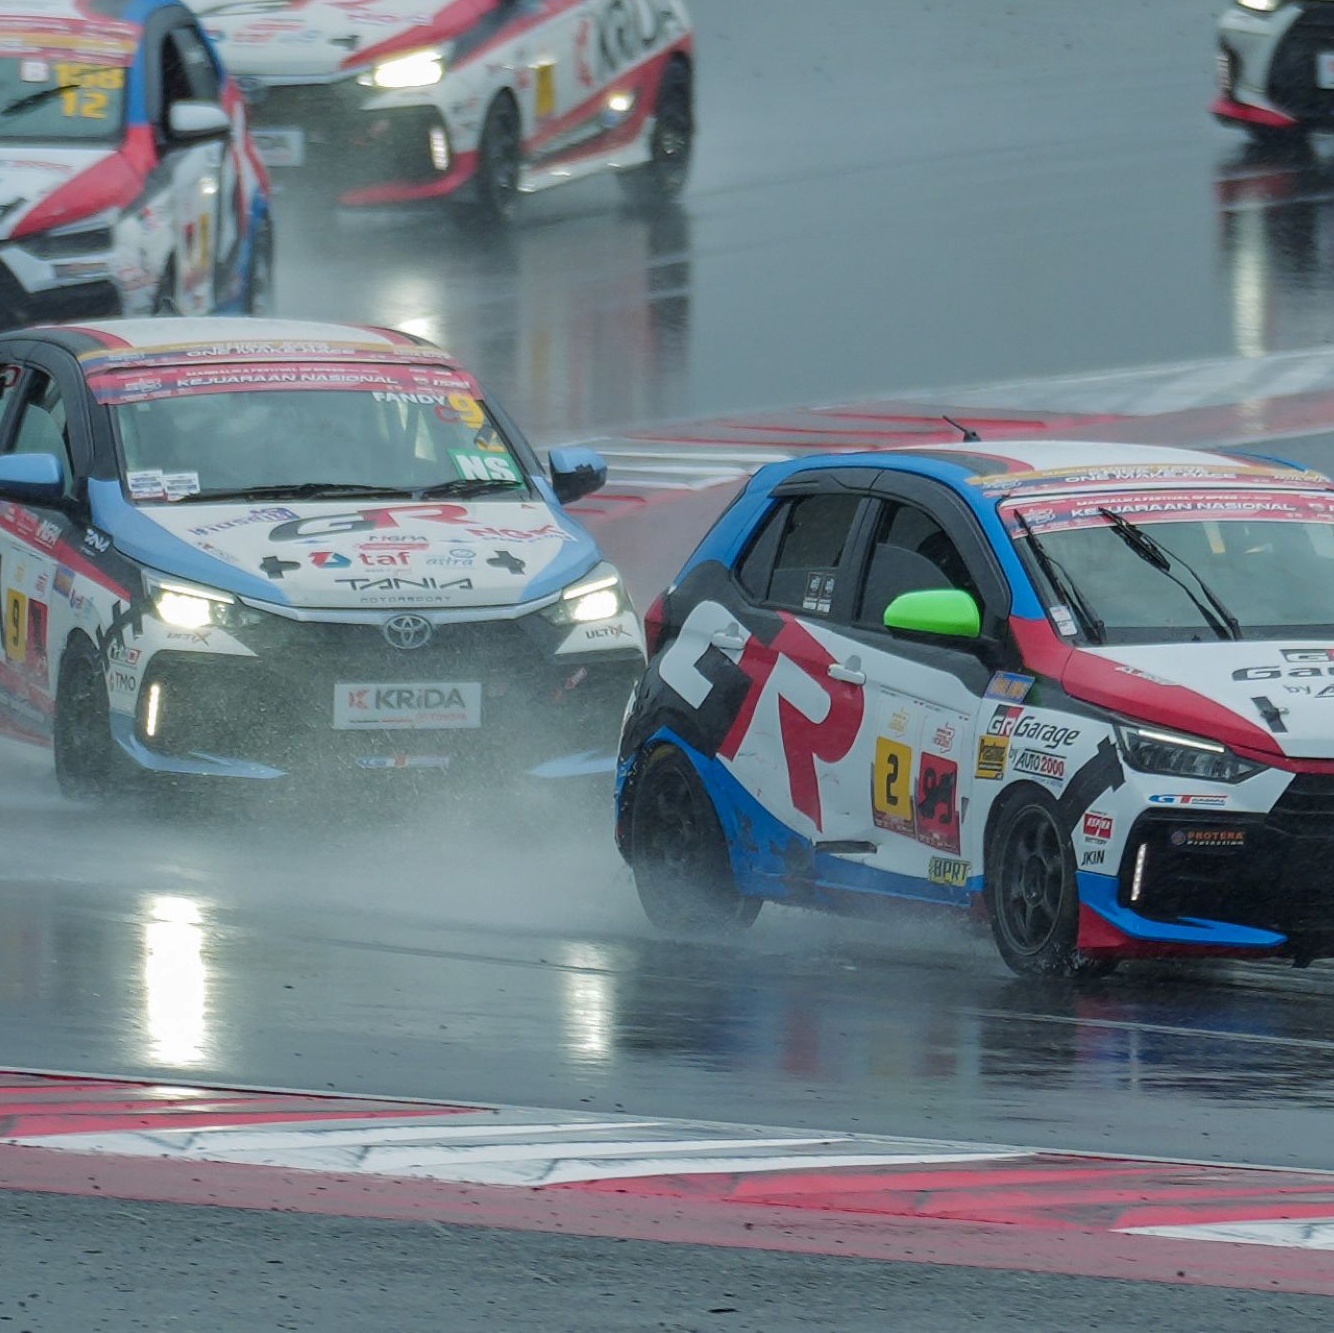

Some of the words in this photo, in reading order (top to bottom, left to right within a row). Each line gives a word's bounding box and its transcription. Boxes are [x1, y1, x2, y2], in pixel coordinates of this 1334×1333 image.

[177, 375, 296, 388] KEJUARAAN
[301, 374, 399, 385] NASIONAL
[372, 391, 446, 406] FANDY
[448, 393, 485, 430] 9
[455, 454, 518, 481] NS
[1197, 502, 1296, 512] NASIONAL
[268, 504, 483, 542] GR
[358, 551, 411, 566] taf
[426, 555, 474, 567] astra
[335, 577, 474, 591] TANIA
[1283, 684, 1311, 695] by
[1013, 715, 1081, 750] Garage
[1014, 750, 1066, 778] AUTO2000
[886, 753, 899, 806] 2
